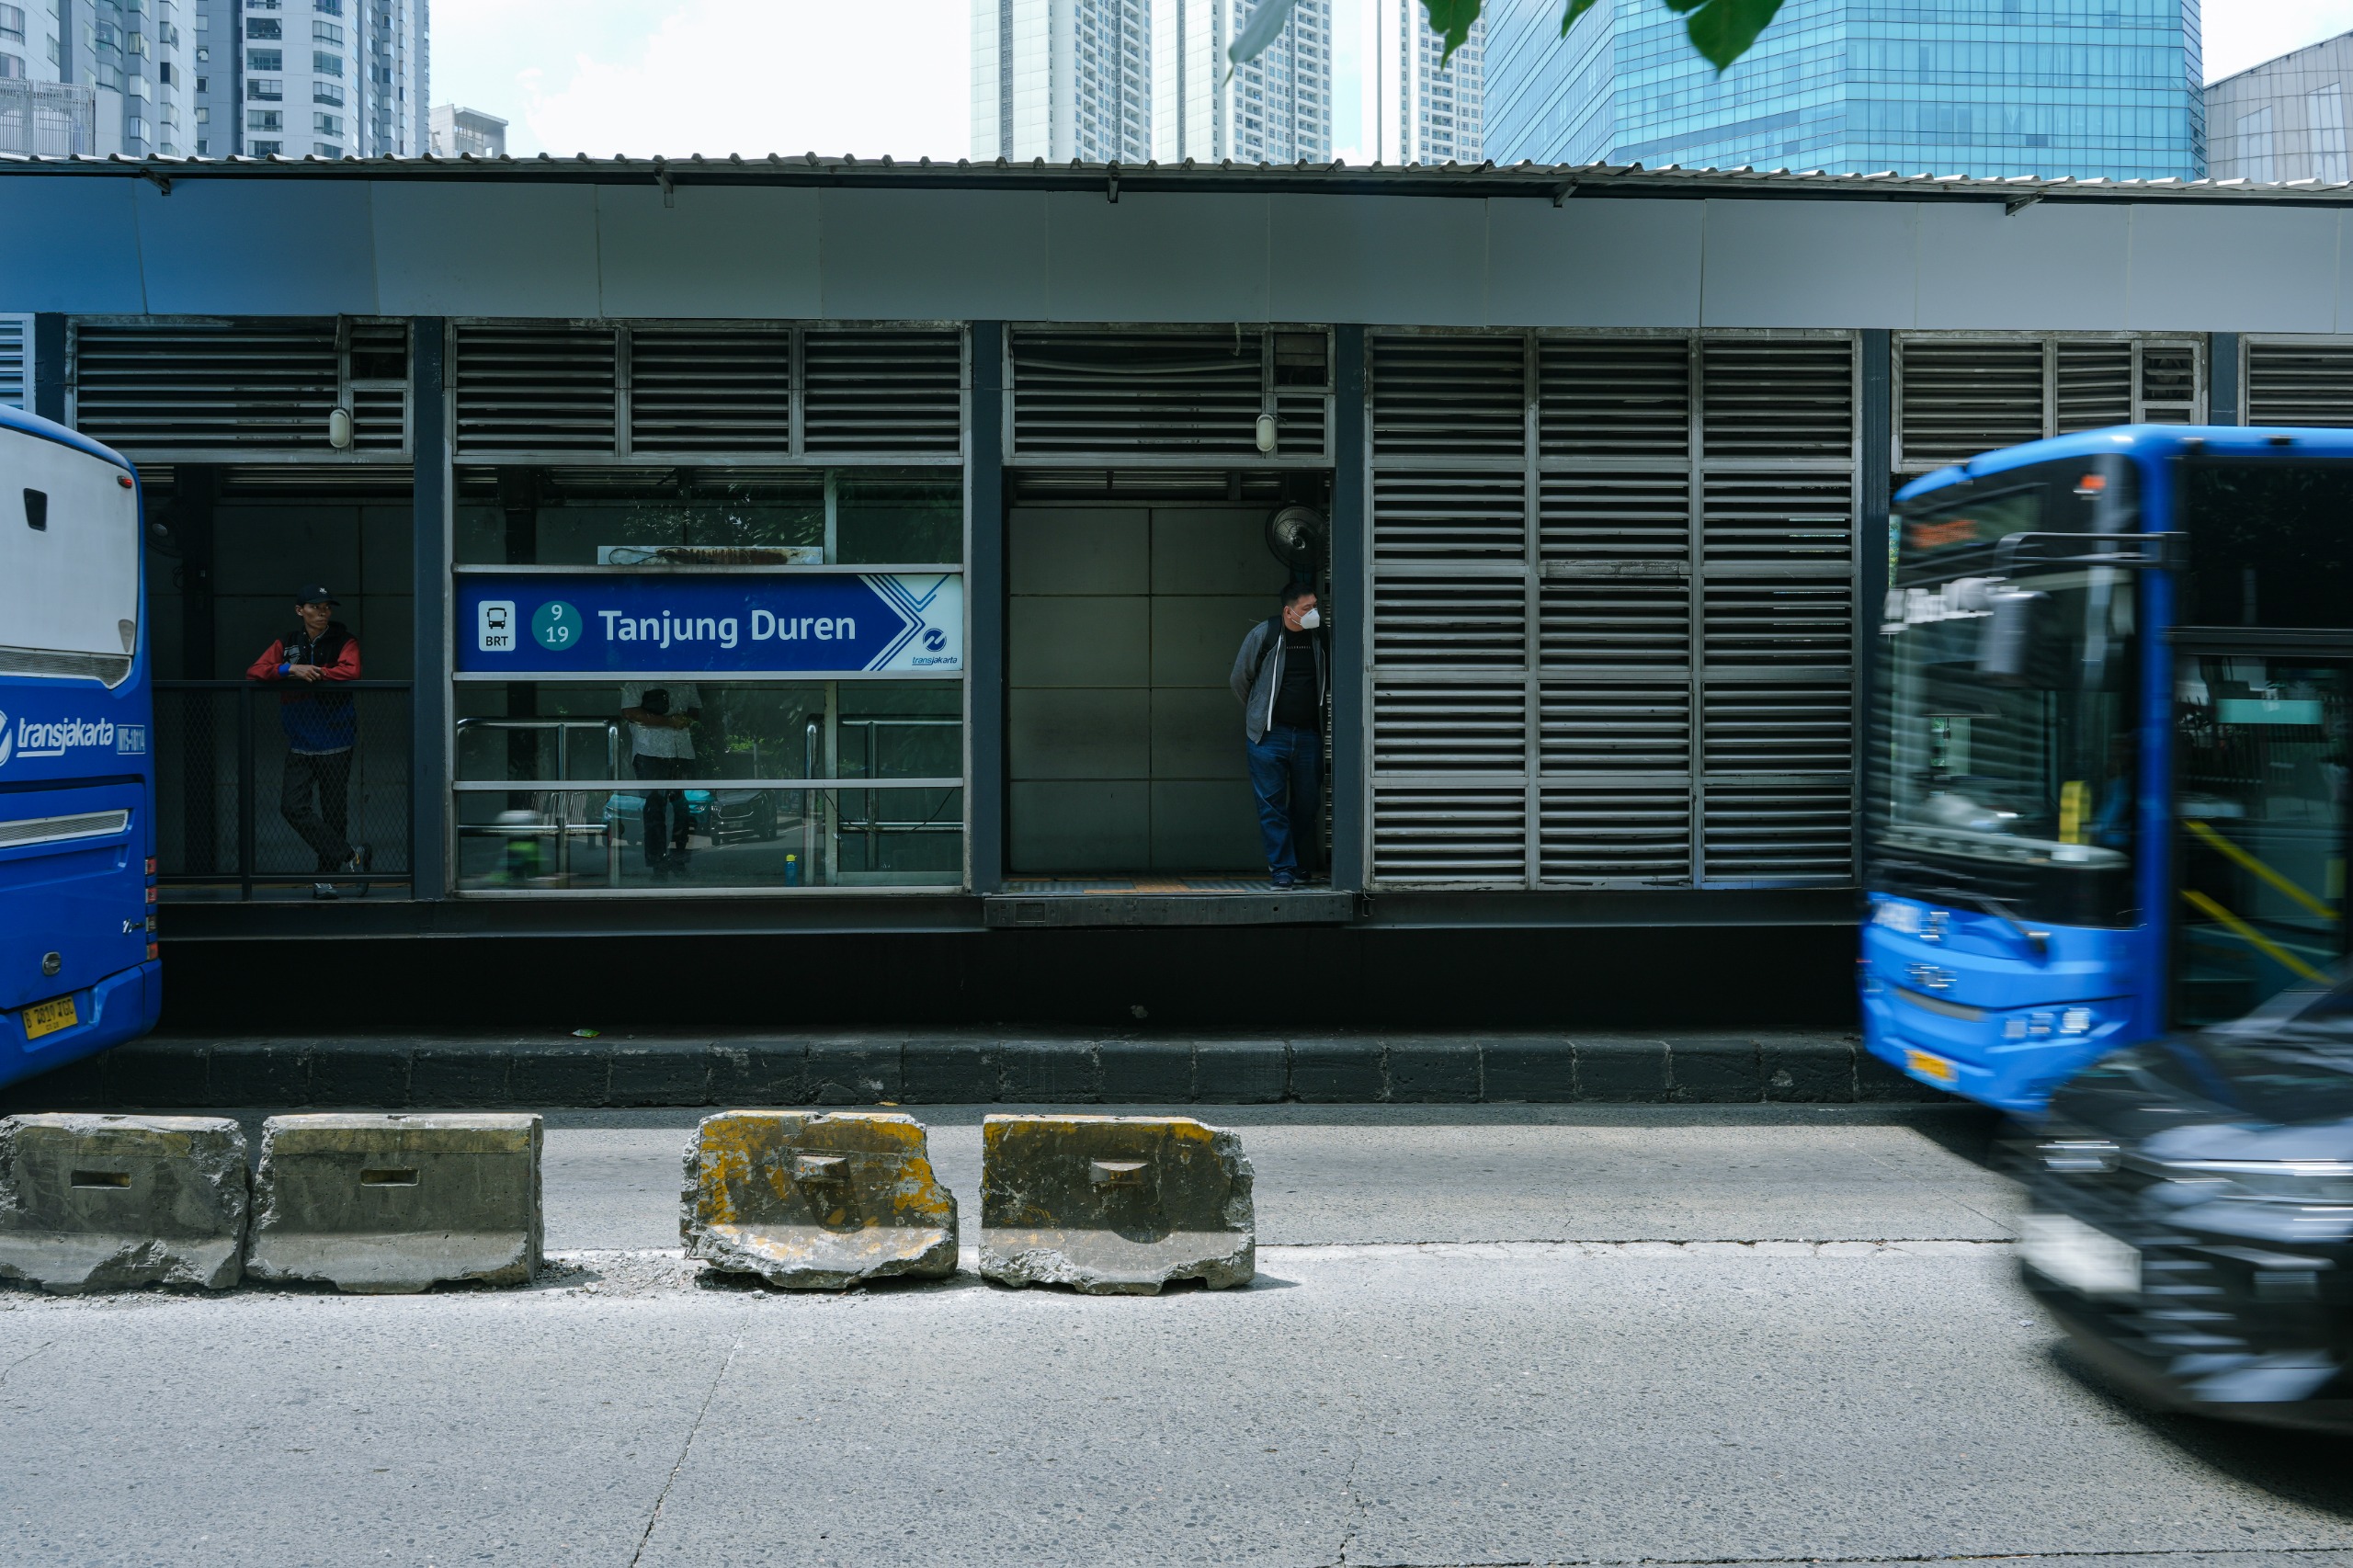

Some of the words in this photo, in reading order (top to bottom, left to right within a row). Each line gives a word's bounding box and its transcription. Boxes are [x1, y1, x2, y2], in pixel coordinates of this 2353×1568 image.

[551, 604, 563, 621] 9
[546, 627, 569, 643] 19
[597, 609, 738, 649] Tanjung
[751, 609, 857, 641] Duren
[485, 635, 509, 647] BRT
[912, 656, 958, 666] transjakarta
[16, 717, 115, 758] transjakarta
